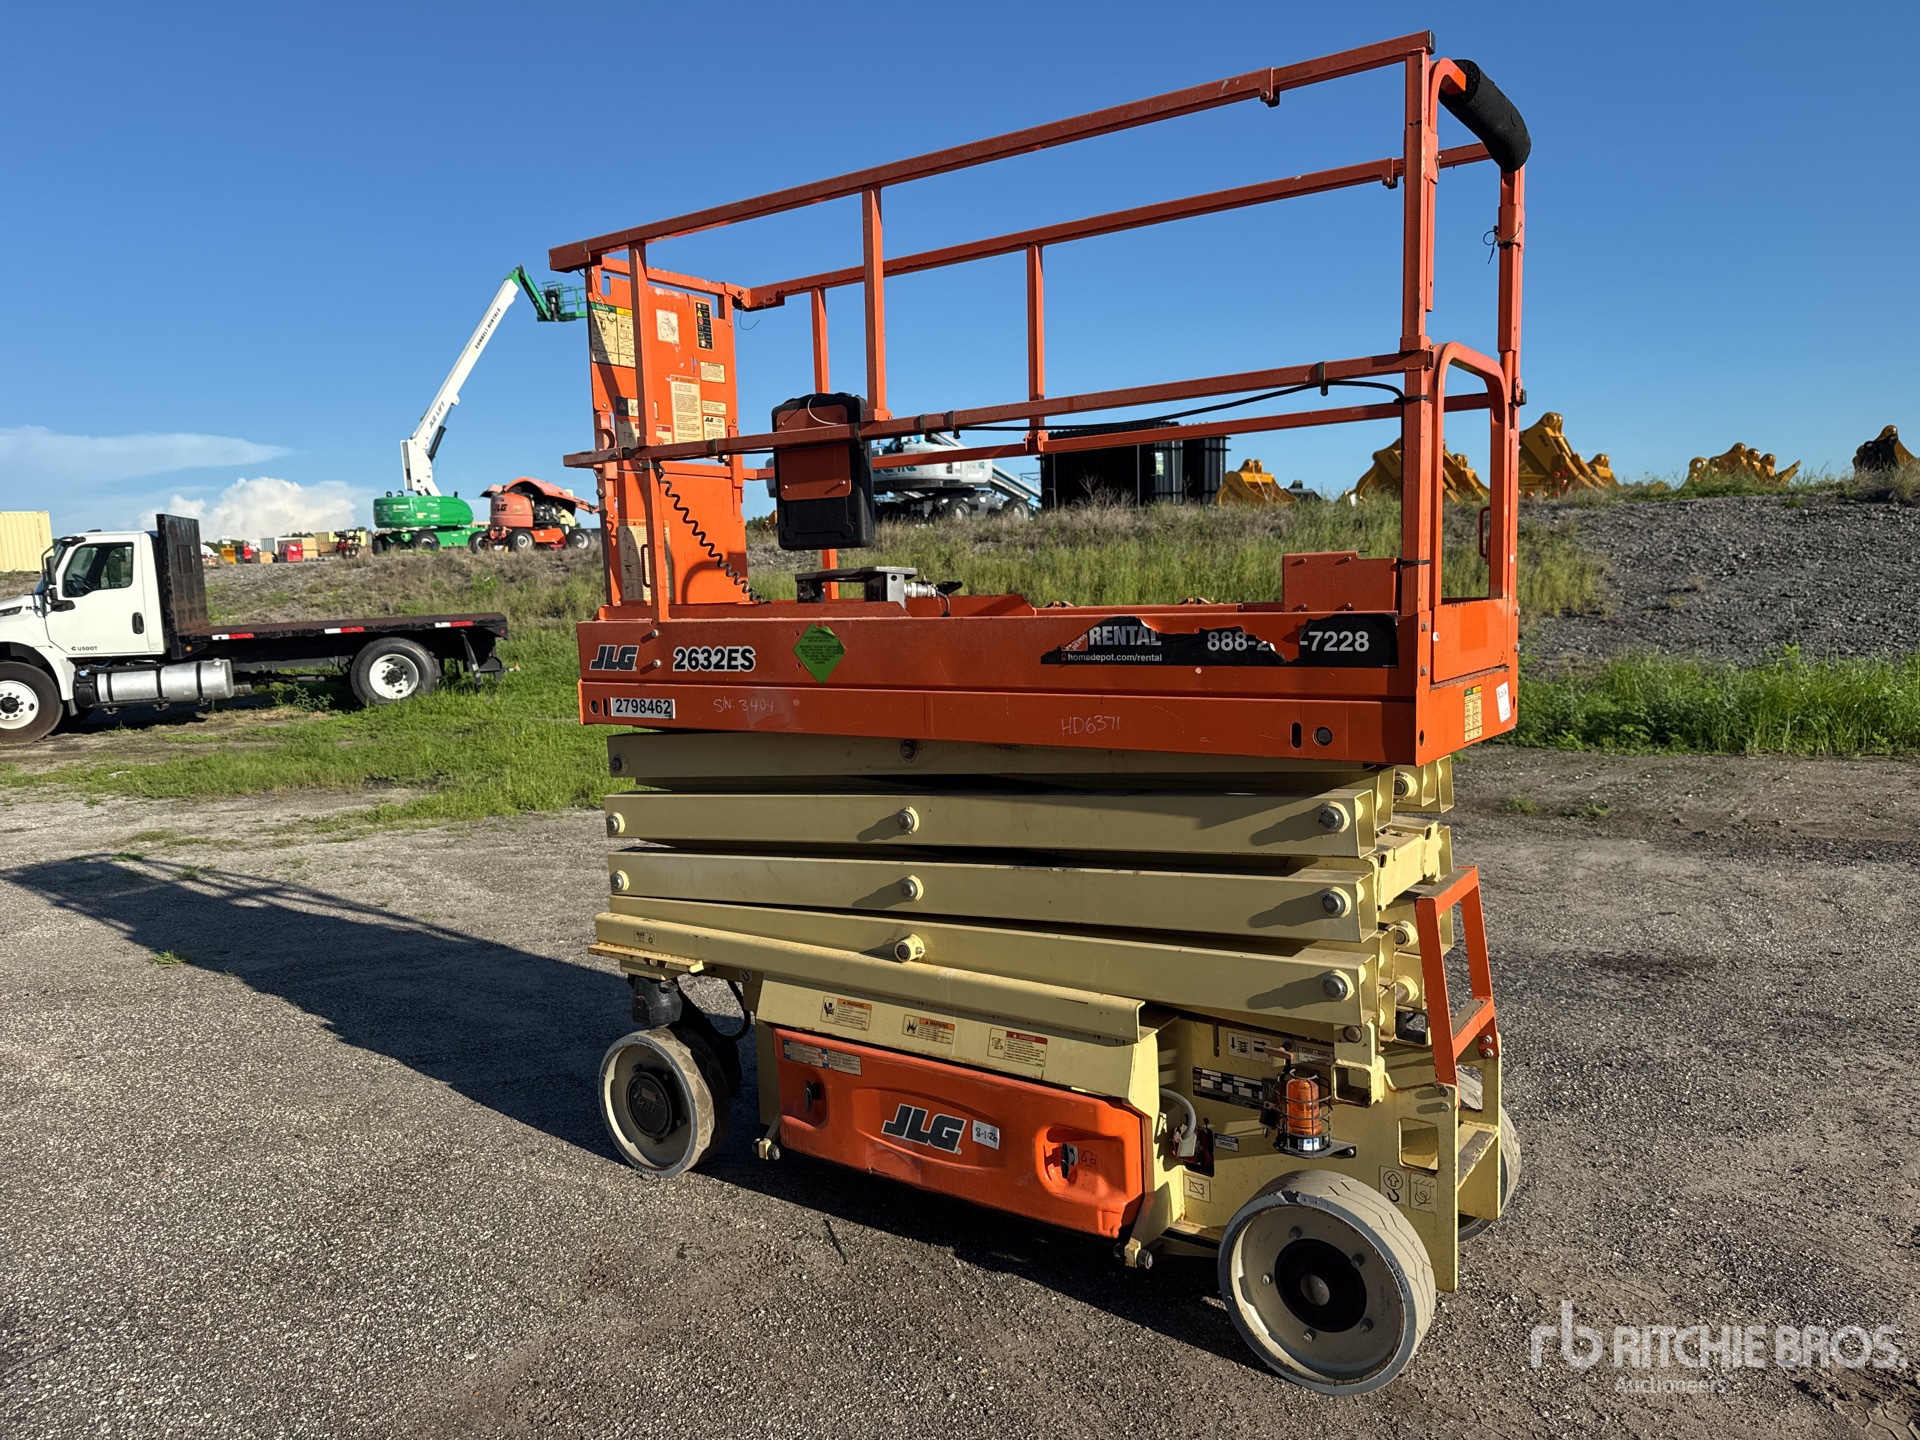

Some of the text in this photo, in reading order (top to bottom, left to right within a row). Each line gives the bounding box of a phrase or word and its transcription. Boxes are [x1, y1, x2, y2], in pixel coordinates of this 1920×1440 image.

[493, 504, 508, 512] JLG
[1089, 625, 1162, 646] RENTAL
[590, 644, 639, 671] JLG
[672, 645, 757, 673] 2632ES
[1067, 653, 1162, 663] homedepot.com/rental
[615, 698, 671, 715] 2798462
[1061, 714, 1120, 737] HD6371
[881, 1102, 967, 1154] JLG
